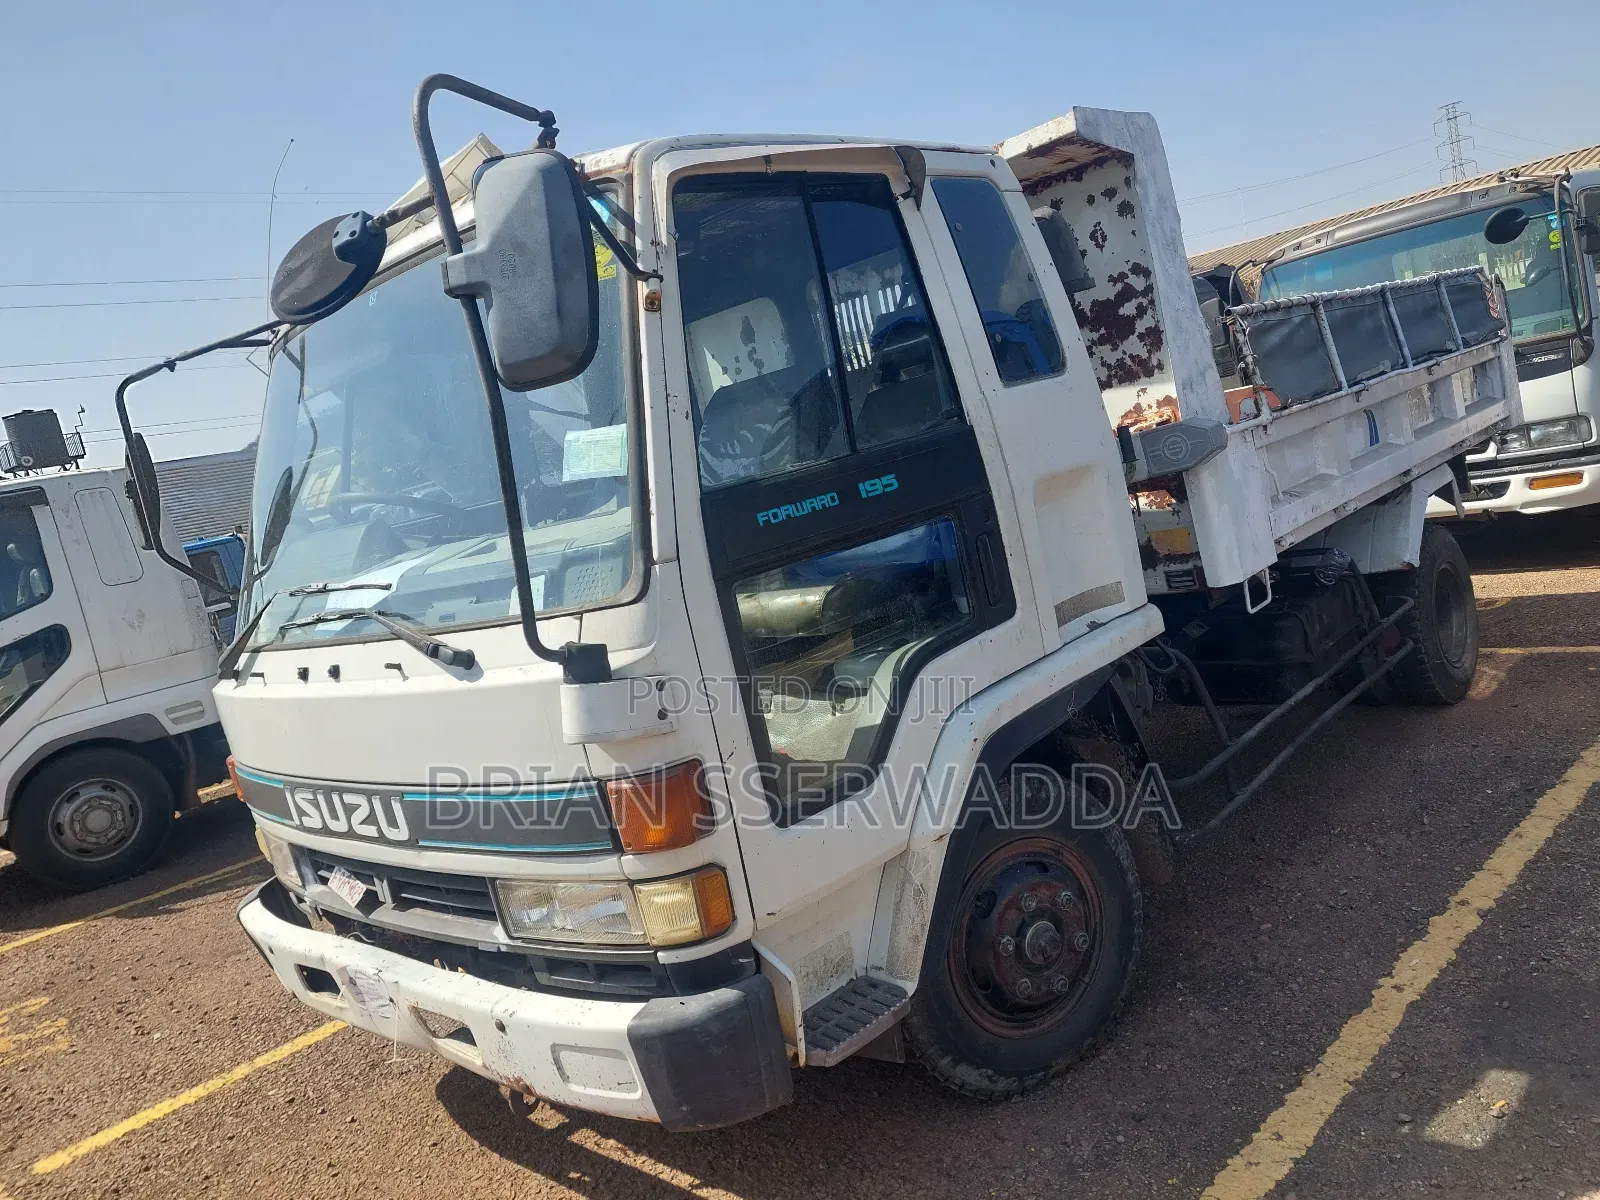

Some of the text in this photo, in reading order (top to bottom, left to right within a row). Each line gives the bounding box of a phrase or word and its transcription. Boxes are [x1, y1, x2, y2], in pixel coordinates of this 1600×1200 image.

[756, 474, 899, 526] FORWARD 195
[284, 785, 411, 841] ISUZU
